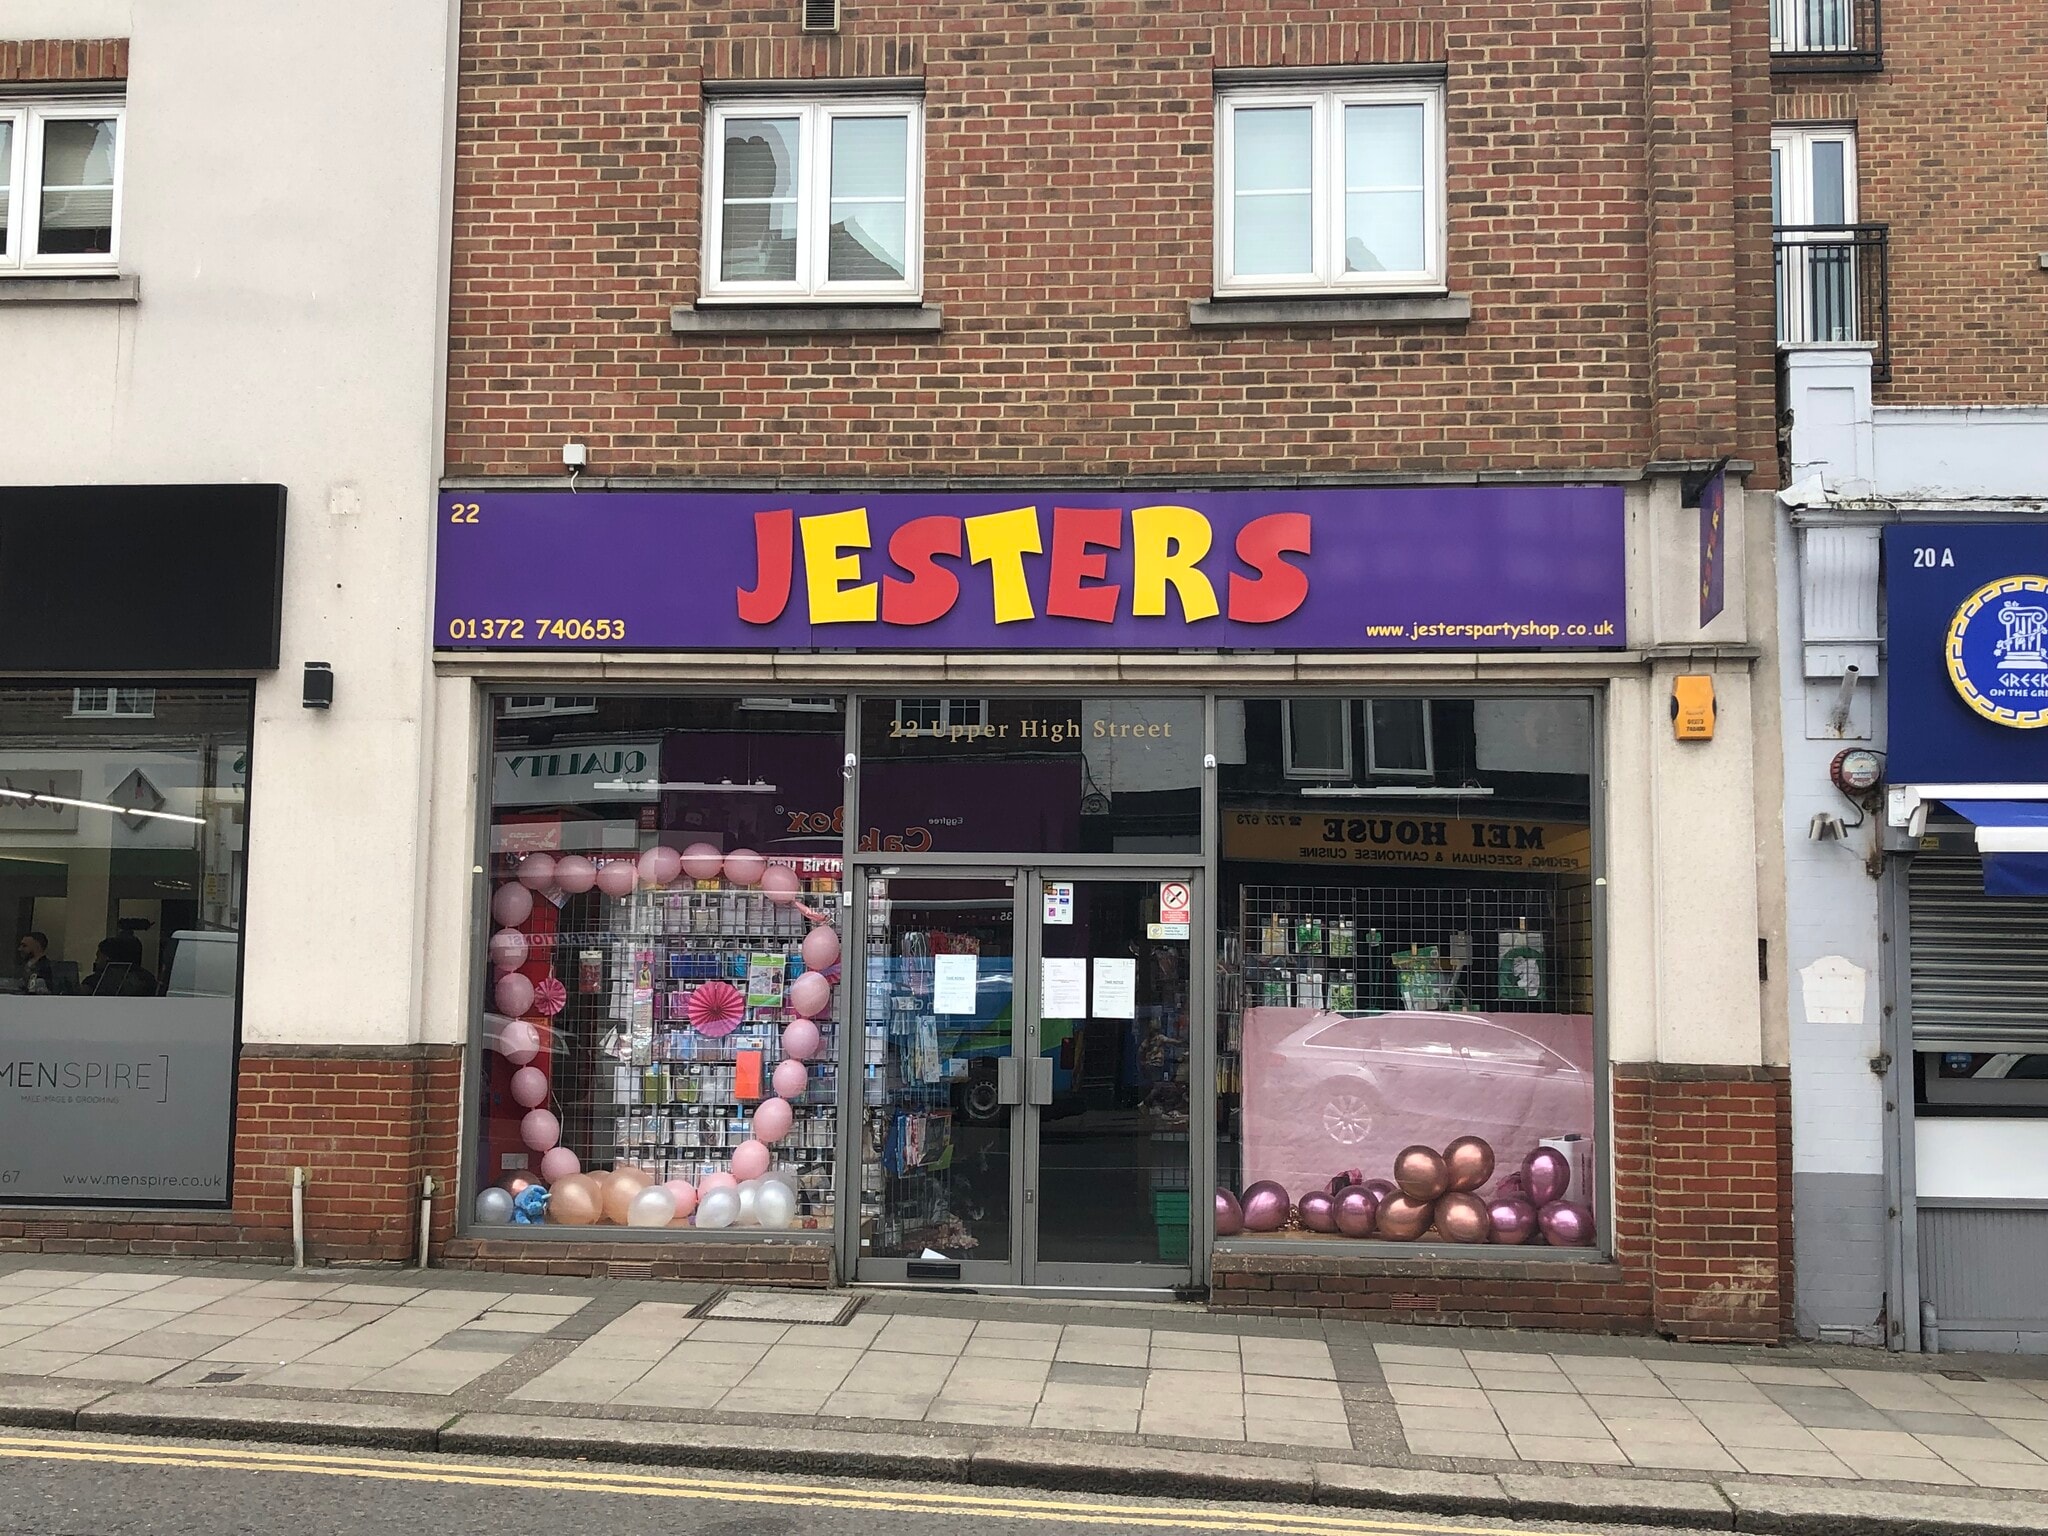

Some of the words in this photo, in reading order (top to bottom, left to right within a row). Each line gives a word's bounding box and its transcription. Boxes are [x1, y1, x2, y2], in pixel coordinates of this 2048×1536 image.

[450, 503, 480, 524] 22
[736, 506, 1311, 625] JESTERS
[1913, 548, 1936, 568] 20
[1940, 548, 1955, 567] A
[449, 619, 525, 640] 01372
[535, 619, 626, 640] 740653
[1365, 620, 1615, 640] www.jesterspartyshop.co.uk
[1999, 673, 2048, 688] GREEK
[1990, 689, 2006, 697] ON
[2008, 689, 2028, 697] THE
[889, 720, 919, 738] 22
[931, 720, 1009, 743] Upper
[1020, 719, 1081, 742] High
[1093, 720, 1172, 738] Street
[0, 1061, 151, 1090] MENSPIRE
[2, 1170, 21, 1184] 67
[63, 1174, 223, 1188] www.menspire.co.uk
